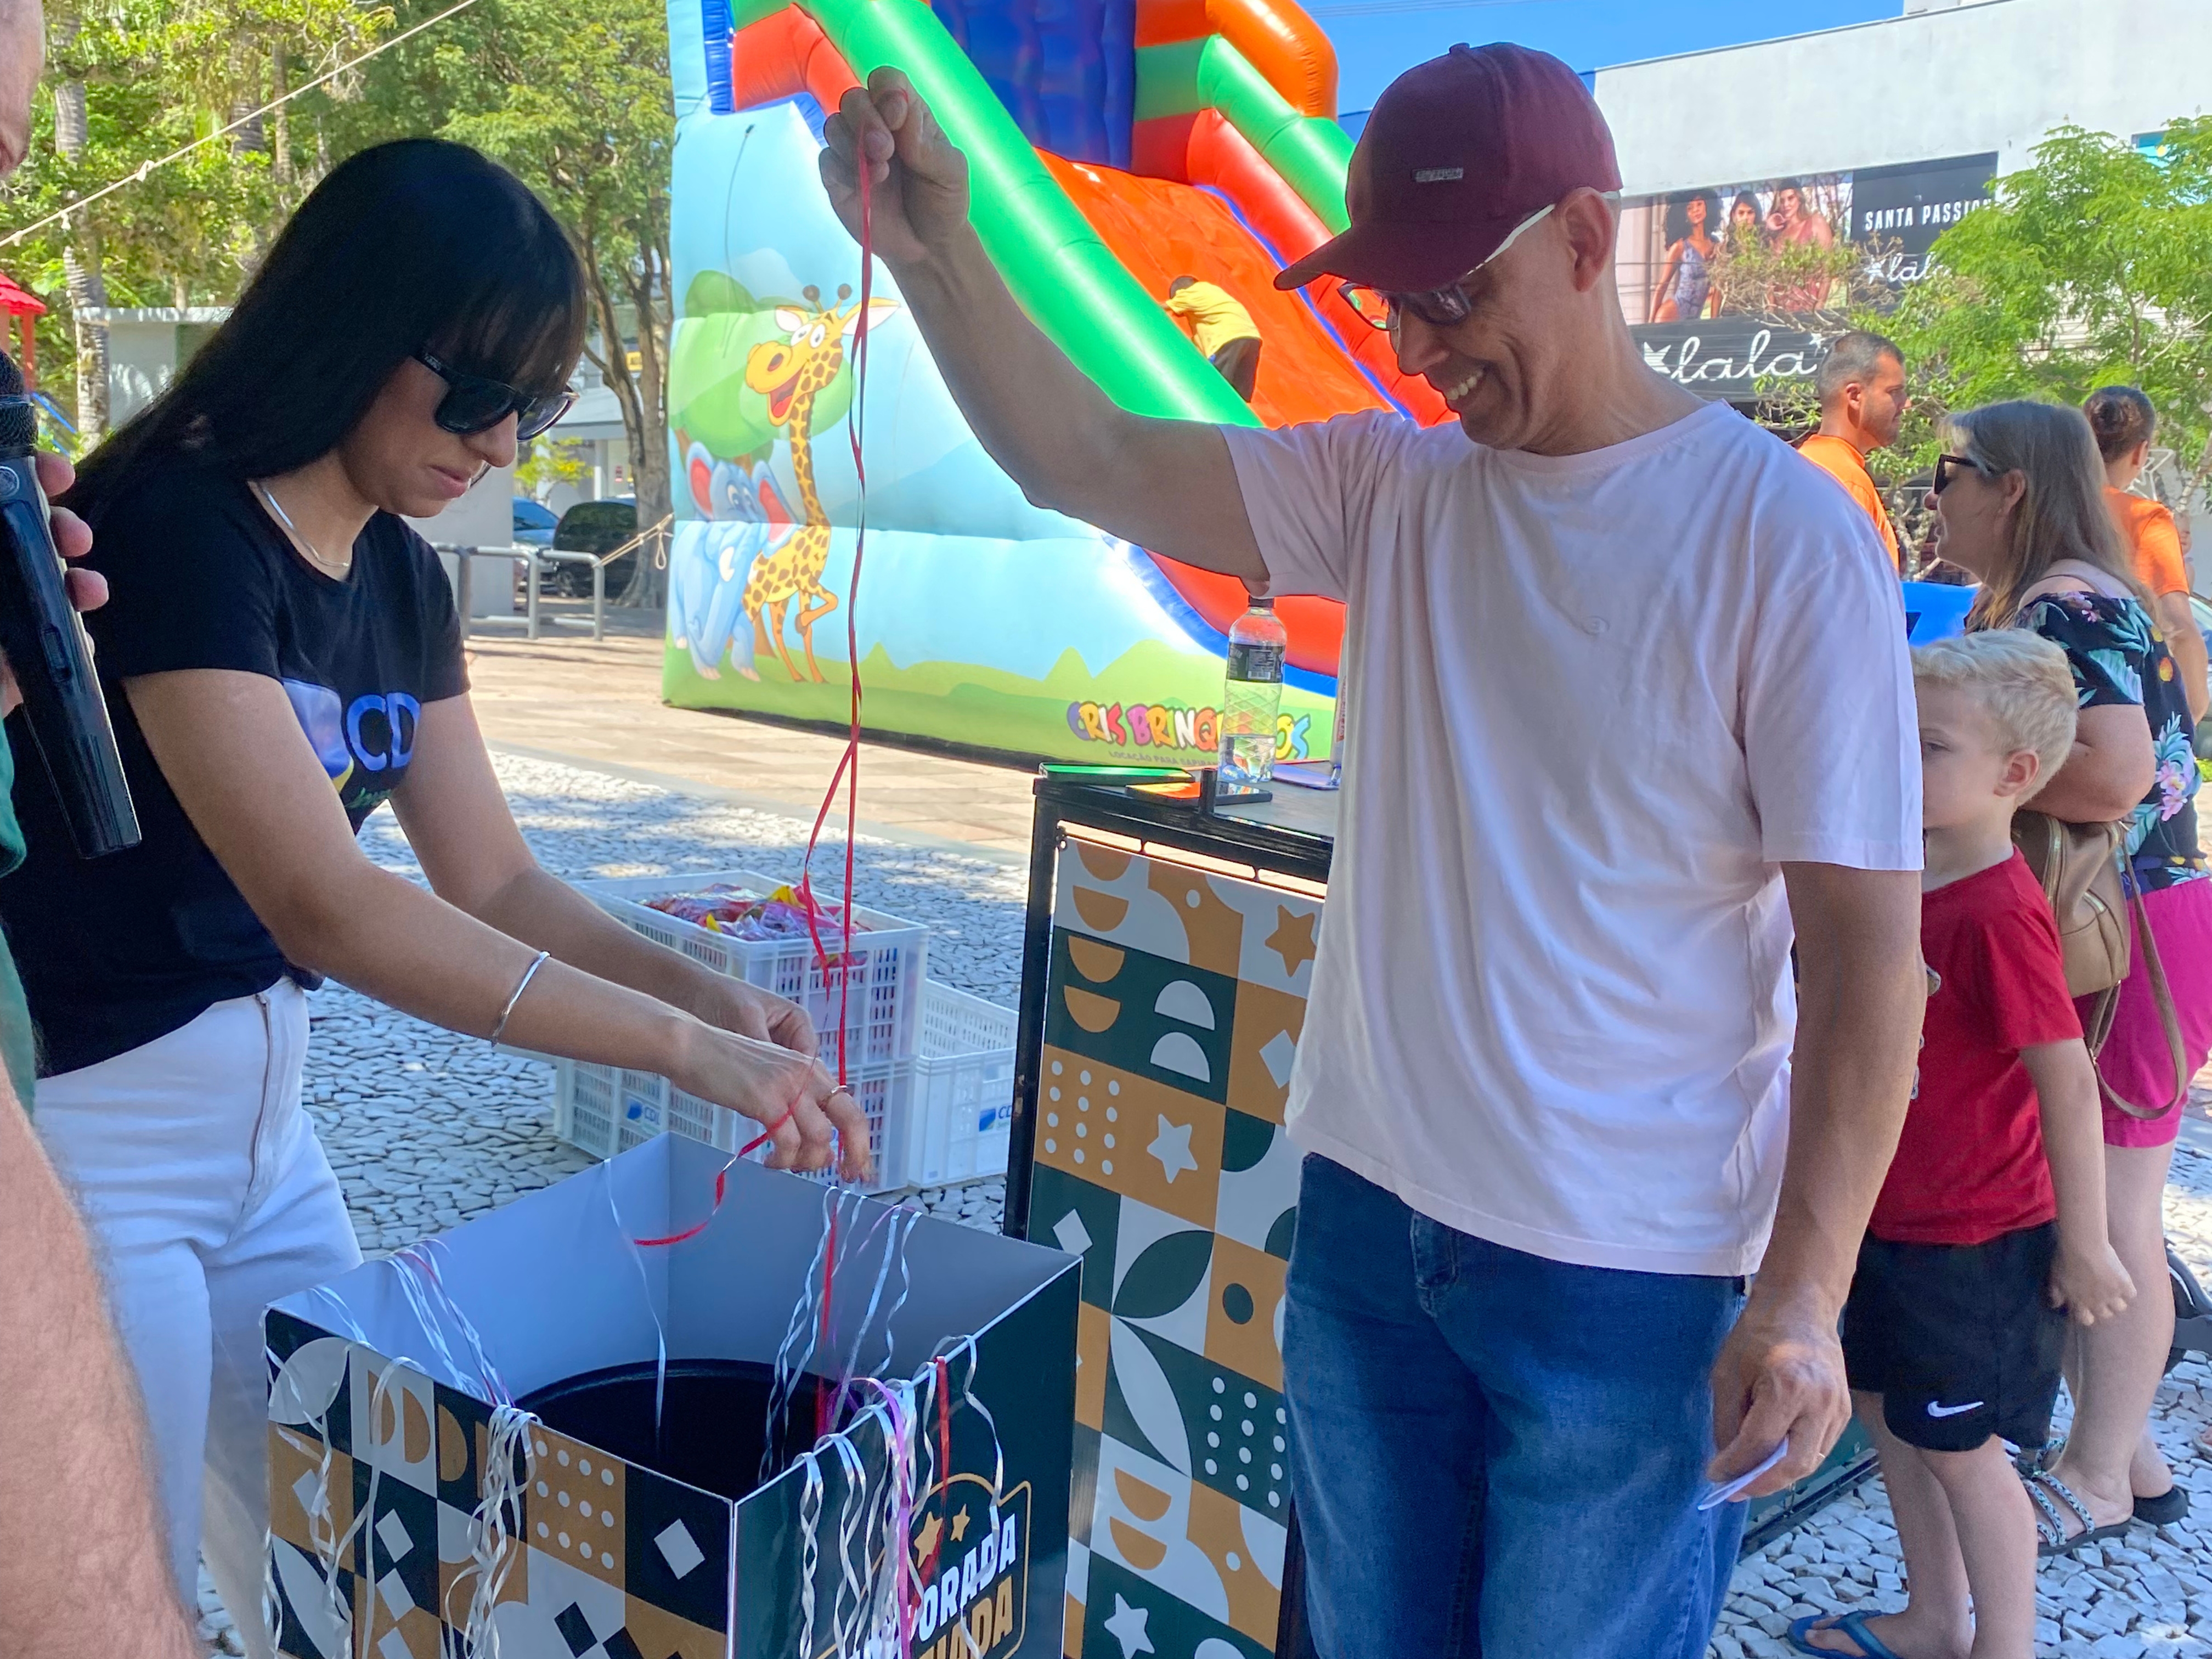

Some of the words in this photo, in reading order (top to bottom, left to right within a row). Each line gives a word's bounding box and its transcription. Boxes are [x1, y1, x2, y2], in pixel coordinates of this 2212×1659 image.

[1864, 206, 1914, 232] SANTA
[1671, 329, 1818, 383] lala
[1067, 701, 1127, 747] CRIS
[1126, 703, 1312, 760] BRINQOS
[1108, 750, 1152, 762] LOCAÇÃO
[1153, 754, 1179, 764] PARA
